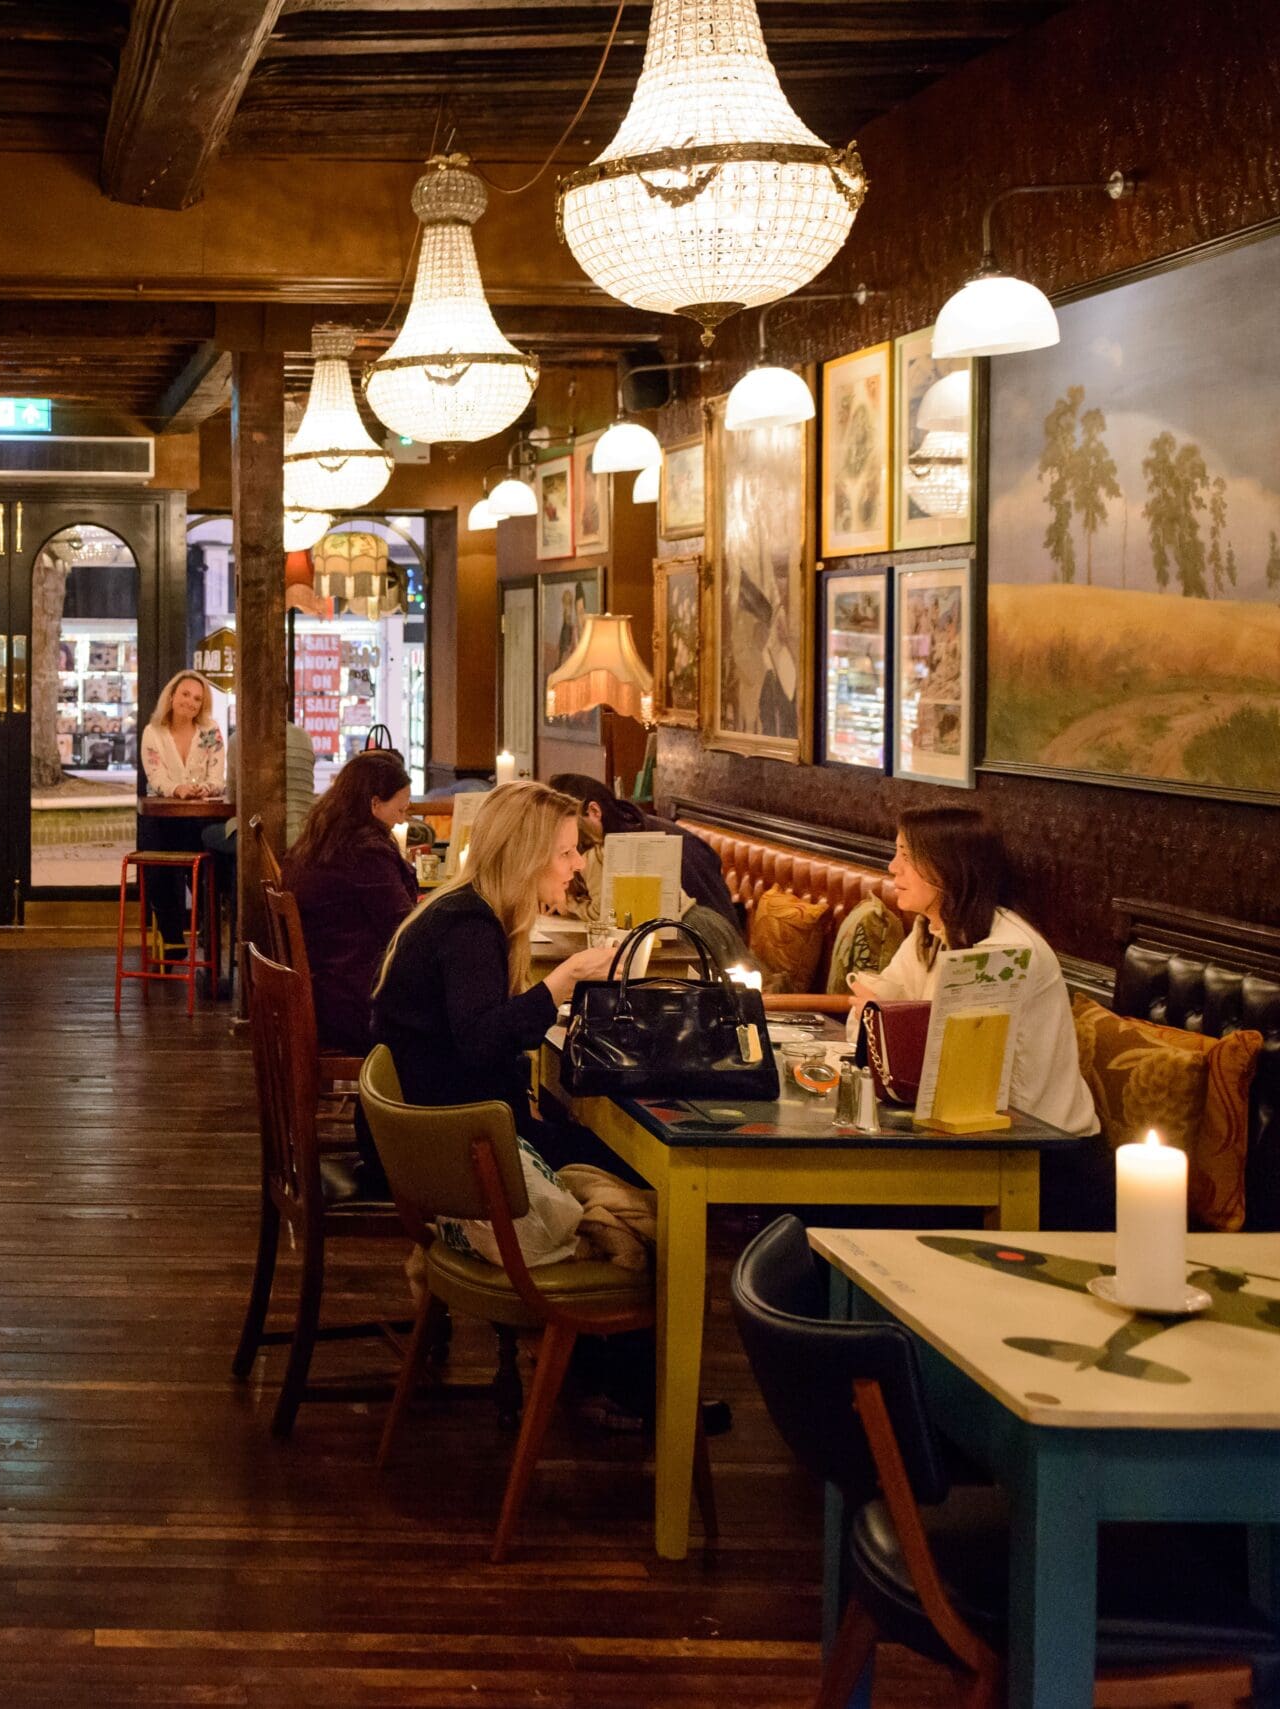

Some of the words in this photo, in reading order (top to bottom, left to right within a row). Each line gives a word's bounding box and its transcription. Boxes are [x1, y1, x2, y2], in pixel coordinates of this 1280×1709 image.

[305, 637, 339, 651] SALE
[305, 656, 339, 670] NOW
[312, 674, 332, 689] ON
[305, 698, 338, 713] SALE
[305, 717, 339, 732] NOW
[312, 736, 332, 751] ON
